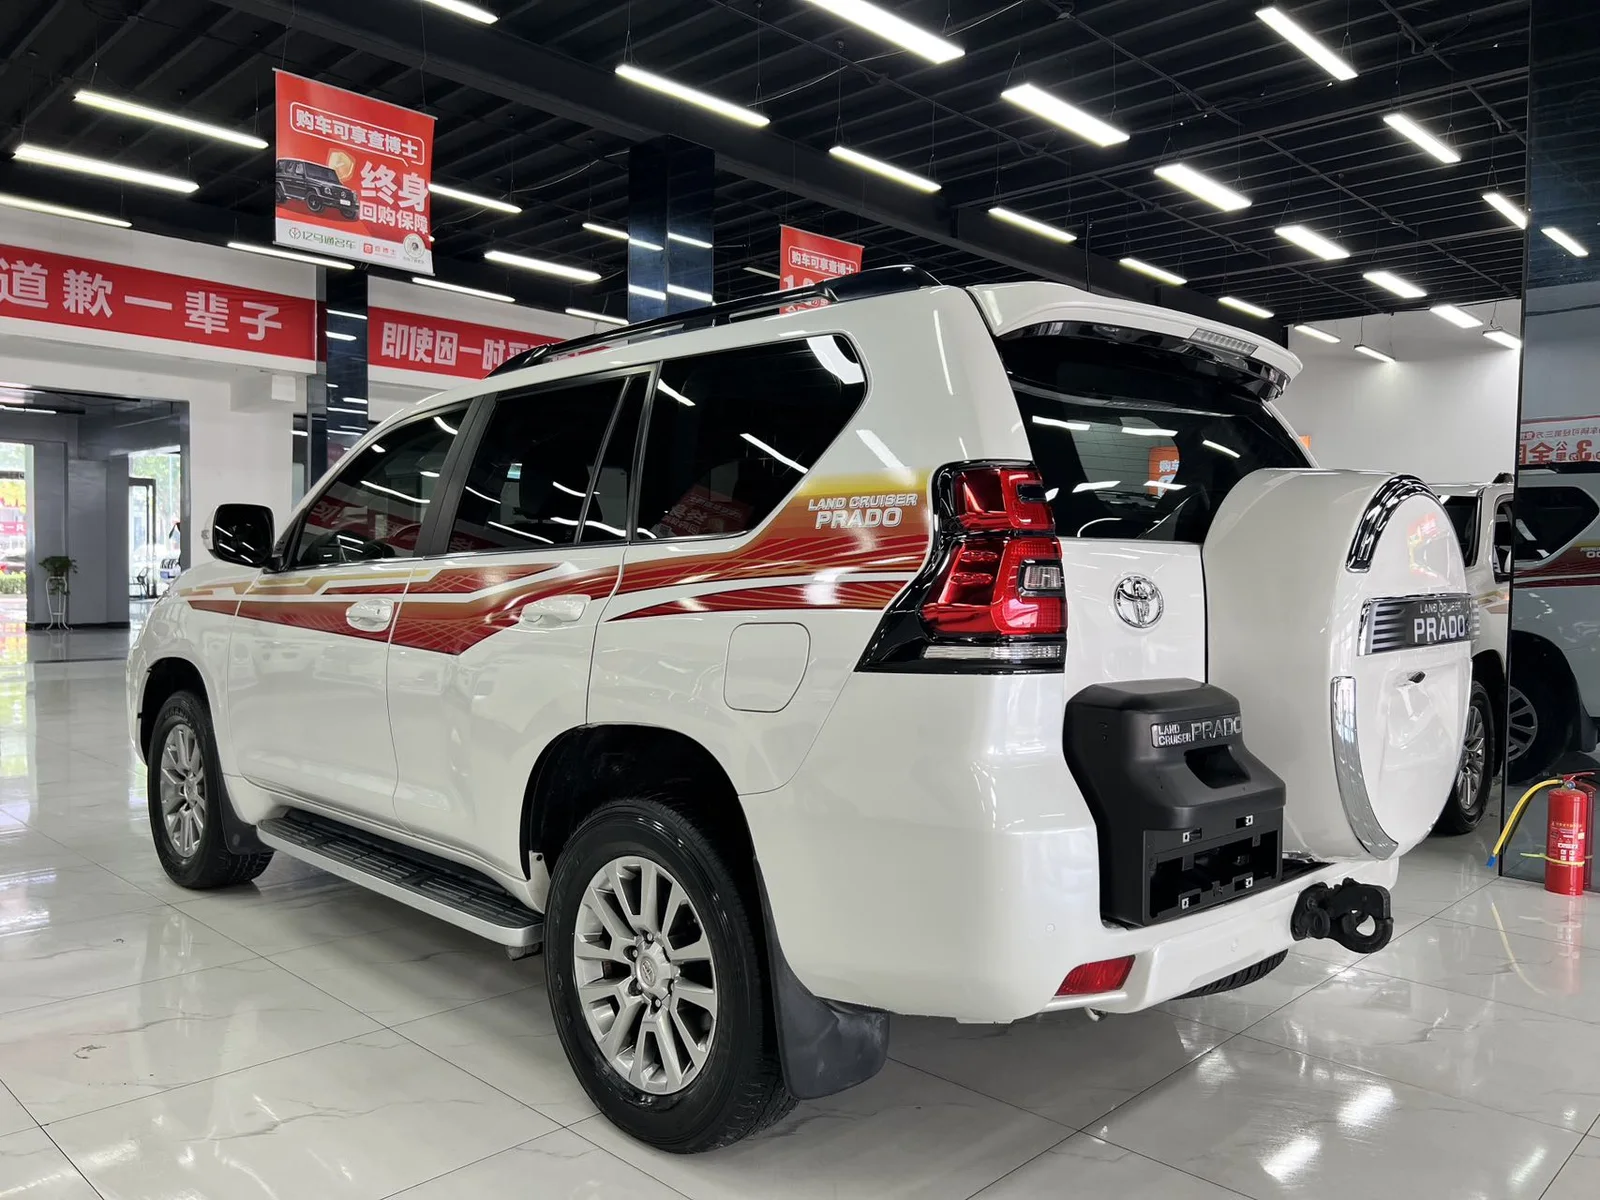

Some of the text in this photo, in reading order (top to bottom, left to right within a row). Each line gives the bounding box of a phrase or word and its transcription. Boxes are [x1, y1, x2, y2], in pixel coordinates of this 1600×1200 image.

[296, 109, 419, 159] 购车可享查博士
[360, 161, 429, 212] 终身
[359, 200, 429, 235] 回购保障
[0, 257, 282, 342] 道歉一辈子
[808, 493, 918, 511] LAND CRUISER
[815, 507, 902, 529] PRADO
[1413, 614, 1465, 643] PRADO
[1158, 724, 1180, 735] LAND
[1158, 732, 1191, 746] CRUISER
